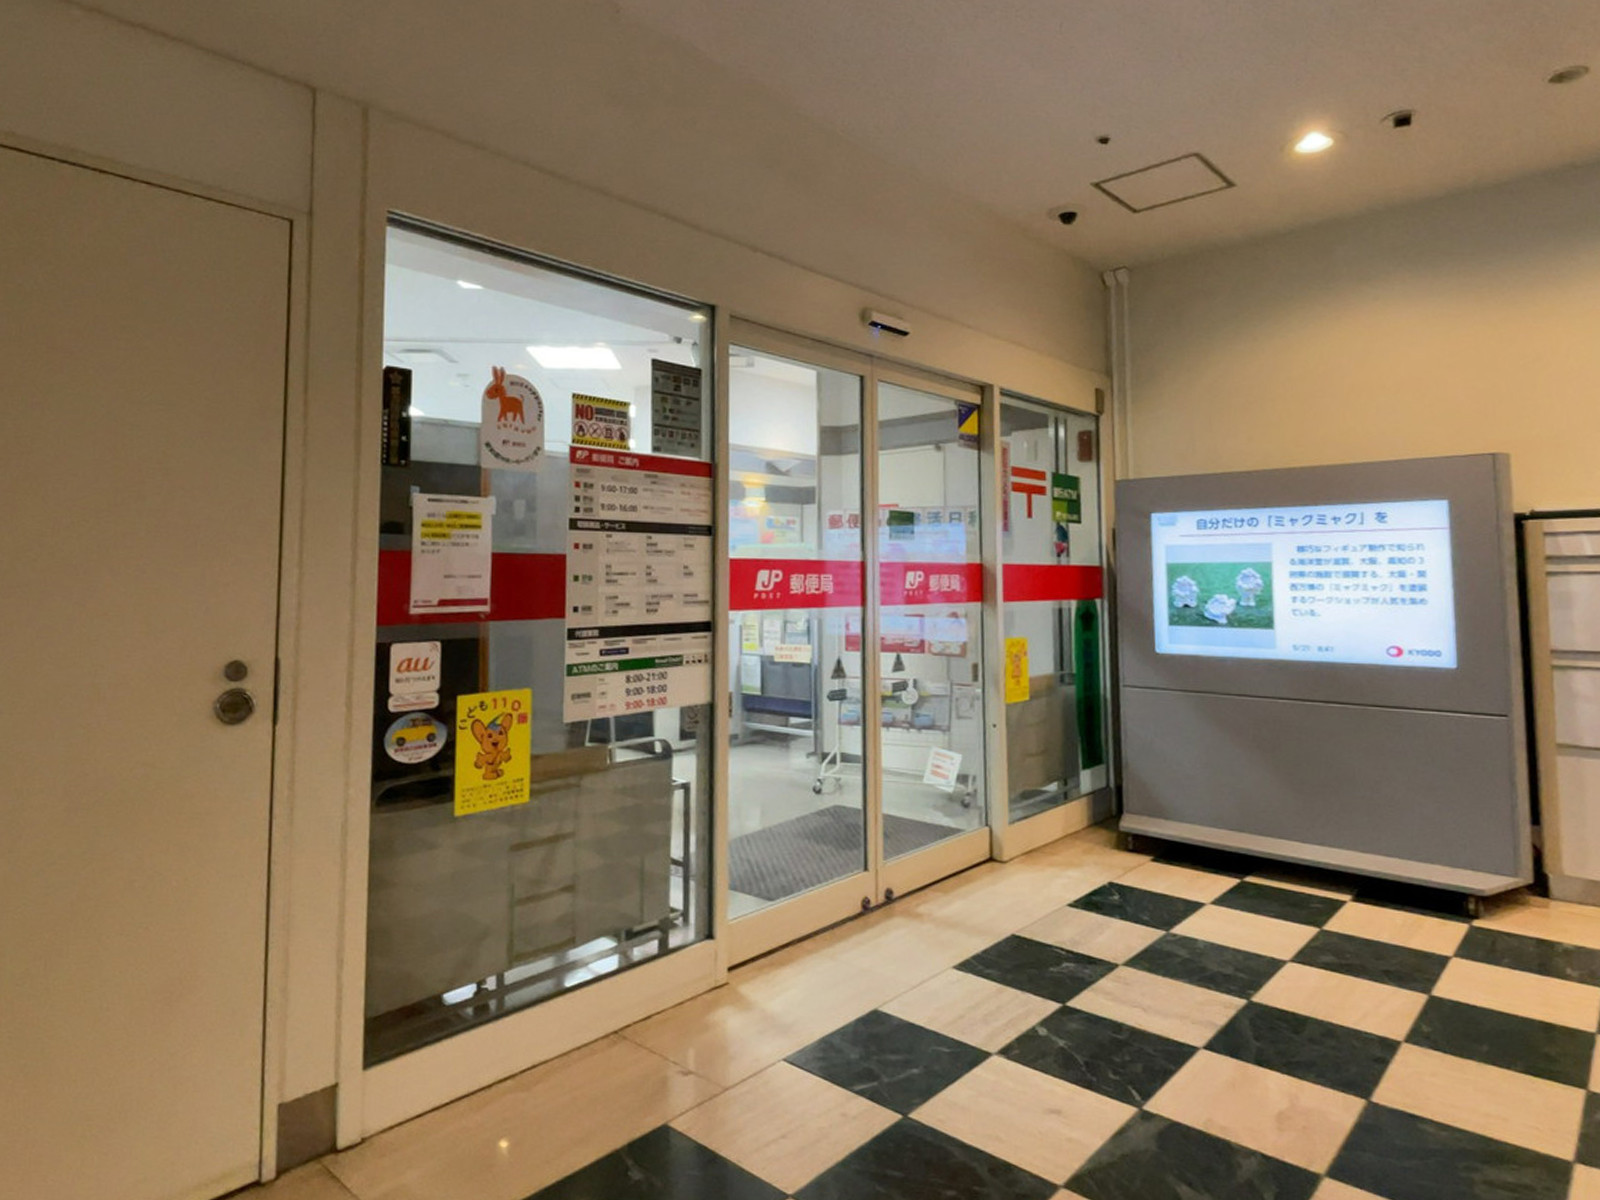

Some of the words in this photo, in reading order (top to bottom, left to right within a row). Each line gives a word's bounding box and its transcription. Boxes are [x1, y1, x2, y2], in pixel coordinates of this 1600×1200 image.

[575, 403, 594, 421] NO
[789, 573, 834, 595] 郵便局
[928, 574, 961, 592] 郵便局
[753, 592, 782, 600] POST
[1407, 649, 1442, 658] KYODO
[396, 657, 435, 674] au
[624, 671, 668, 684] 8:00-21:00
[624, 684, 668, 697] 9:00-18:00
